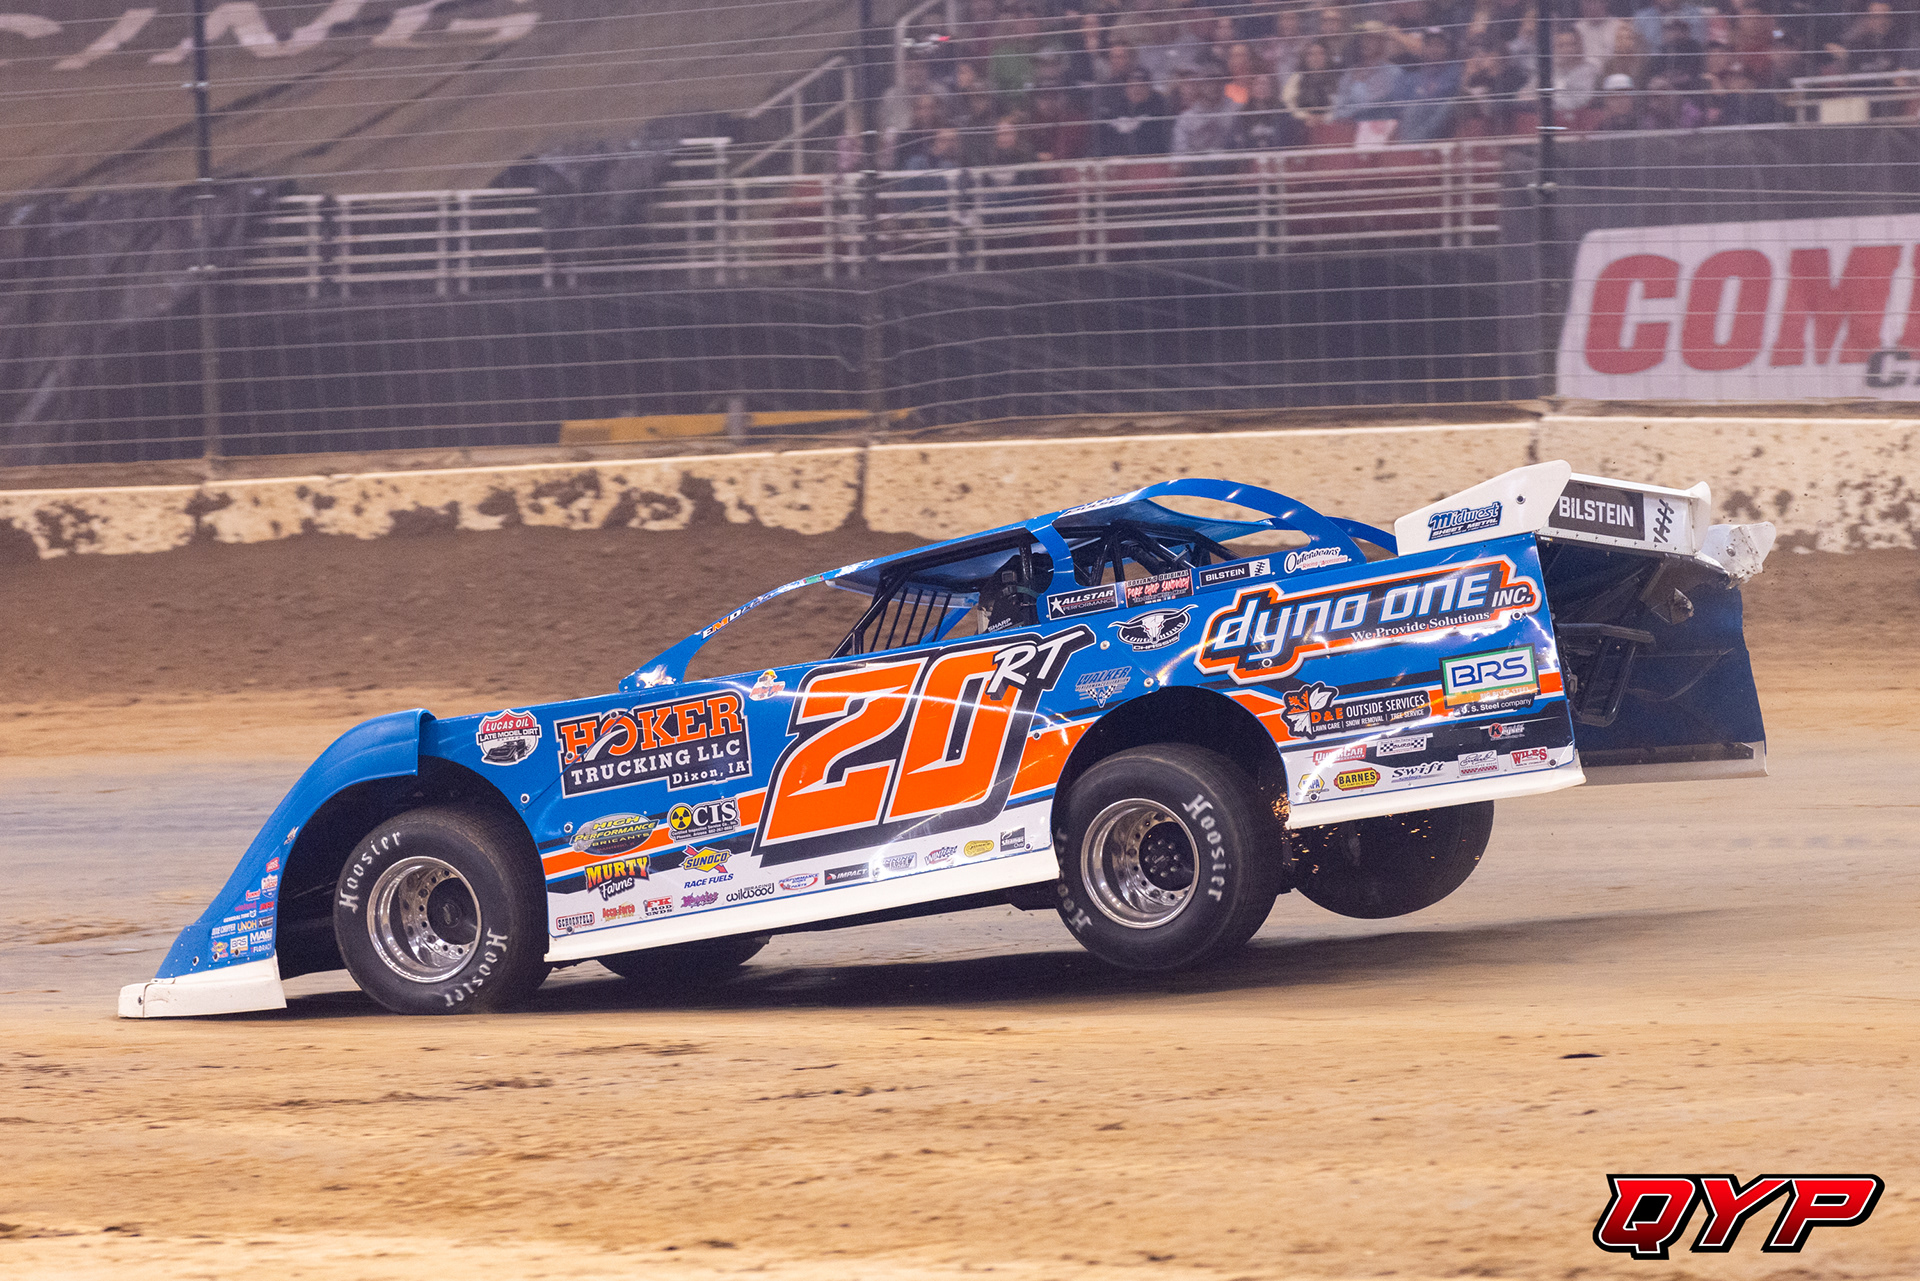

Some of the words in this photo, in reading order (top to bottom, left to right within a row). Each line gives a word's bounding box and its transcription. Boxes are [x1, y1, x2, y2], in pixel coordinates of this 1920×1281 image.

[1585, 243, 1920, 375] COM
[1866, 350, 1920, 388] C
[1430, 502, 1499, 531] Midwest
[1558, 495, 1635, 528] BILSTEIN
[1432, 525, 1463, 537] SHEET
[1467, 518, 1498, 529] METAL
[1285, 547, 1340, 573] Outerwears
[1159, 570, 1190, 582] ORIGINAL
[1205, 568, 1246, 582] BILSTEIN
[1062, 590, 1114, 605] ALLSTAR
[1127, 586, 1144, 599] PORK
[1144, 582, 1160, 596] CHOP
[1380, 573, 1491, 622] ONE
[1491, 586, 1532, 607] INC.
[1063, 599, 1115, 611] PERFORMANCE
[1351, 631, 1372, 642] We
[1375, 622, 1427, 638] Provide
[1429, 611, 1491, 629] Solutions
[1133, 636, 1179, 650] CHASSIS
[1077, 666, 1131, 686] WALKER
[1451, 656, 1527, 688] BRS
[1346, 702, 1383, 718] OUTSIDE
[1386, 695, 1425, 711] SERVICES
[1480, 701, 1500, 711] Steel
[1501, 698, 1532, 709] company
[485, 720, 514, 732] LUCAS
[515, 718, 530, 728] OIL
[561, 695, 742, 764] HOKER
[1313, 723, 1327, 732] LAWN
[1328, 721, 1341, 730] CARE
[1345, 719, 1360, 727] SNOW
[1361, 716, 1384, 725] REMOVAL
[1404, 709, 1424, 718] SERVICE
[480, 732, 498, 742] LATE
[498, 730, 522, 738] MODEL
[761, 642, 1022, 848] 20
[986, 630, 1087, 695] RT
[571, 749, 691, 785] TRUCKING
[697, 739, 741, 762] LLC
[1512, 748, 1548, 765] WILES
[672, 767, 723, 785] Dixon,
[728, 760, 746, 773] IA
[1338, 771, 1376, 785] BARNES
[1392, 763, 1444, 778] Swift
[593, 815, 640, 830] HIGH
[692, 800, 737, 827] CIS
[574, 822, 656, 843] PERFORMANCE
[577, 833, 650, 849] LUBRICANTS
[1181, 793, 1231, 902] Hoosier
[685, 852, 728, 868] SUNOCO
[339, 831, 402, 913] Hoosier
[586, 857, 647, 889] MURTY
[684, 878, 708, 889] RACE
[708, 874, 734, 884] FUELS
[778, 873, 819, 884] PERFORMANCE
[837, 869, 867, 879] IMPACT
[599, 877, 633, 899] Farms
[725, 883, 775, 903] wilwood
[647, 897, 673, 907] FK
[651, 904, 672, 912] ROD
[558, 913, 593, 928] SCHOENFELD
[645, 908, 673, 917] ENDS
[237, 920, 257, 932] UNOH
[444, 927, 508, 1007] Hoosier
